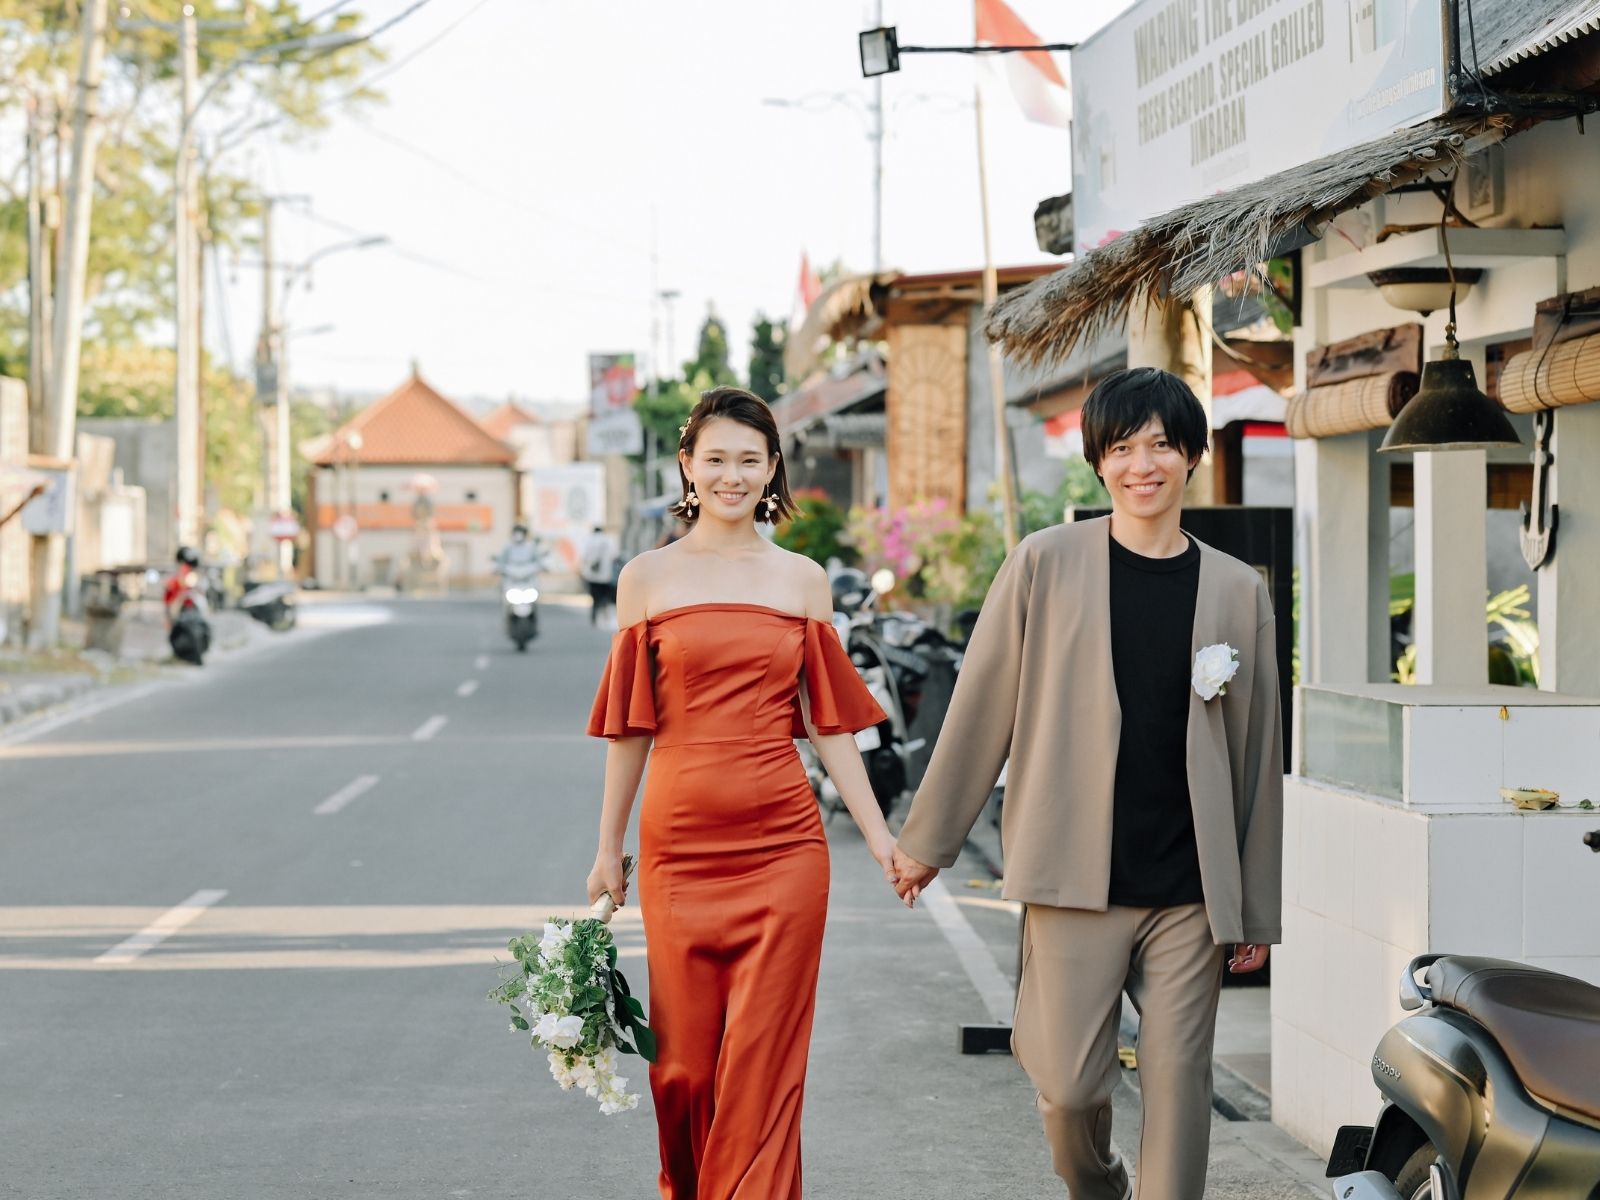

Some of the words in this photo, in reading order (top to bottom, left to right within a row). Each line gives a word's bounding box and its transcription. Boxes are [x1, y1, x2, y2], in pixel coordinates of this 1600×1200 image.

[1134, 0, 1199, 89] WARUNG
[1137, 91, 1168, 147] FRESH
[1219, 30, 1268, 101] SPECIAL
[1271, 0, 1324, 73] GRILLED
[1189, 95, 1246, 168] JIMBARAN
